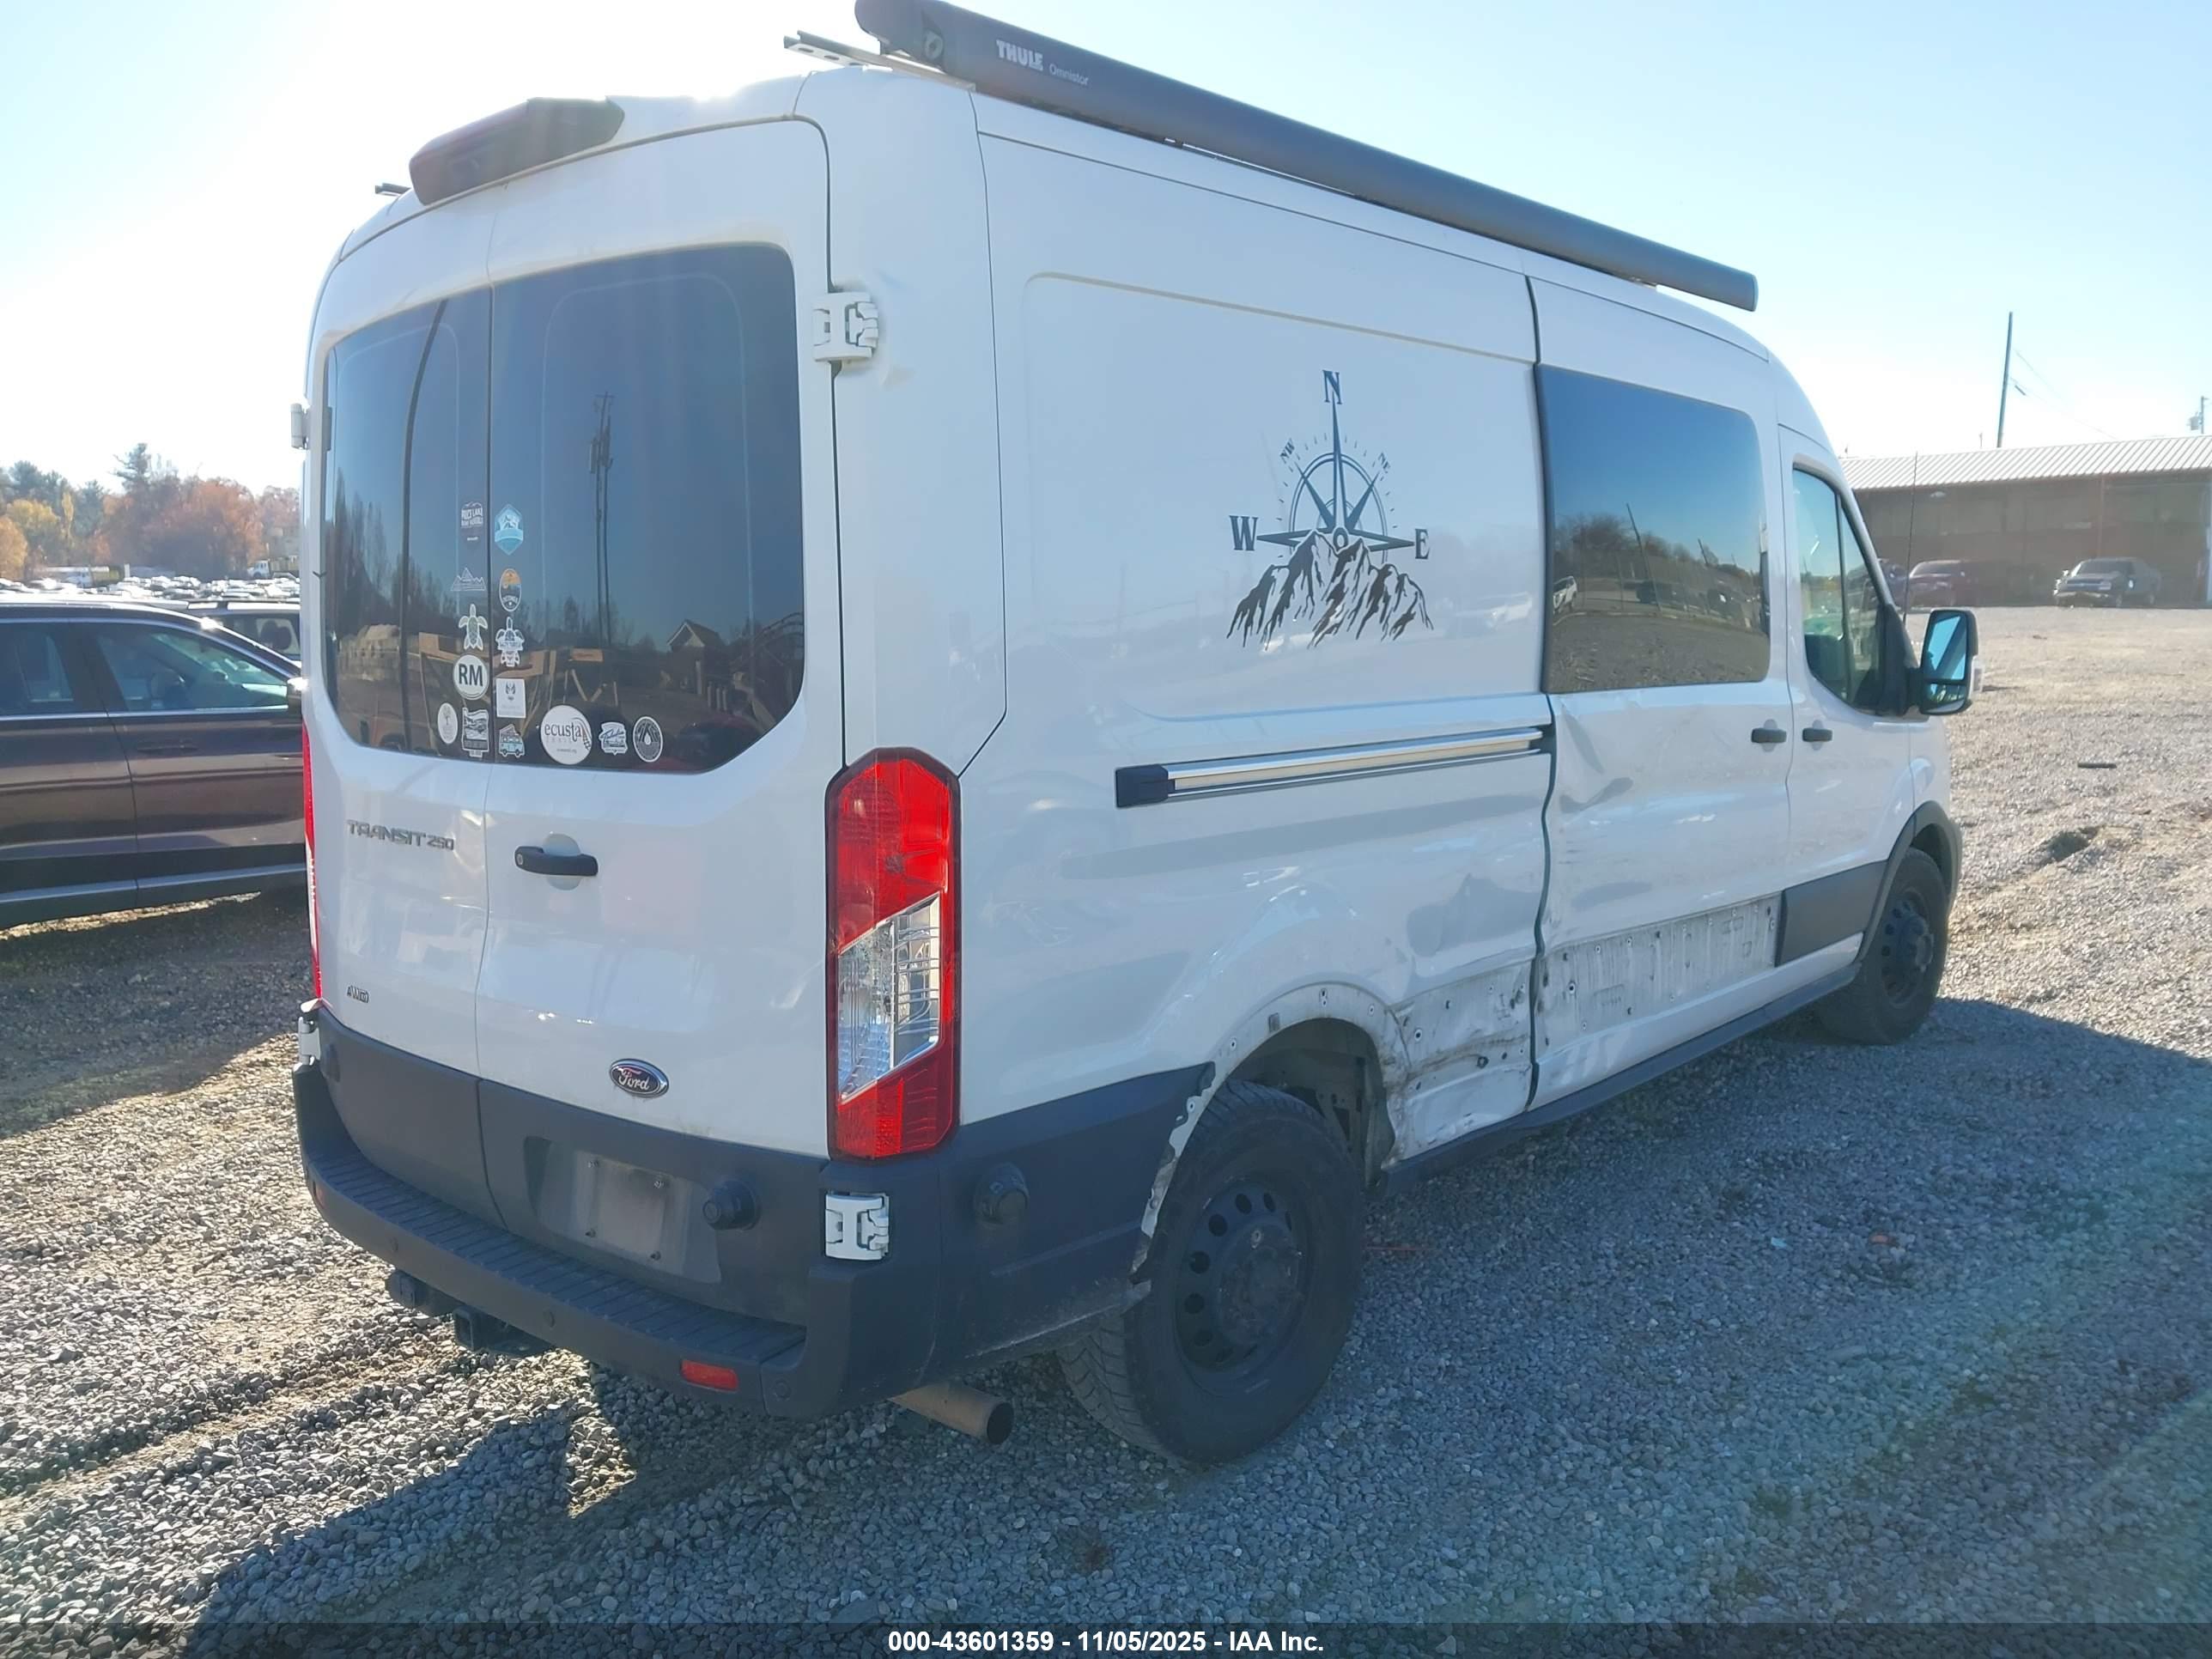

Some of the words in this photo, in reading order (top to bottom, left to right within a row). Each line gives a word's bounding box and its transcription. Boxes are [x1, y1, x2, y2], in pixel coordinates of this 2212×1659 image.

[996, 40, 1043, 71] THULE
[1049, 64, 1089, 86] Omnistor
[1322, 369, 1343, 404] N
[1279, 438, 1297, 463] NW
[1230, 515, 1258, 550] W
[1415, 529, 1429, 560] E
[459, 665, 483, 687] RM
[544, 722, 581, 743] ecusta
[347, 820, 426, 847] TRANSIT
[427, 834, 454, 851] 250
[347, 986, 369, 1004] AWD
[617, 1068, 651, 1091] Ford
